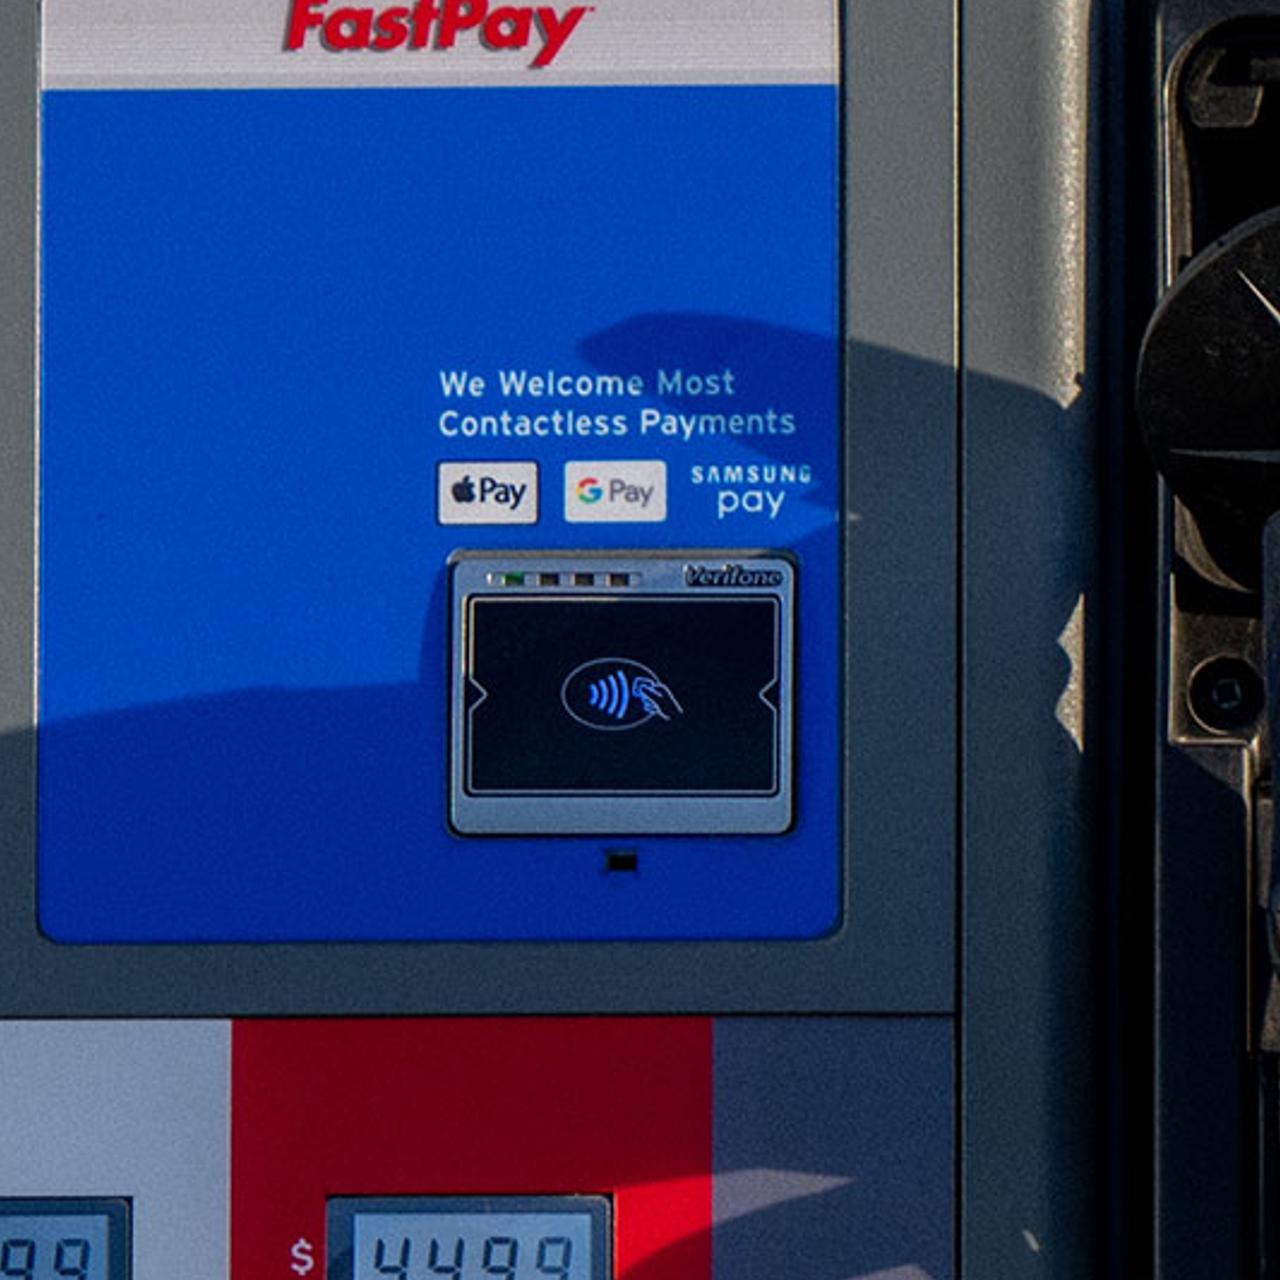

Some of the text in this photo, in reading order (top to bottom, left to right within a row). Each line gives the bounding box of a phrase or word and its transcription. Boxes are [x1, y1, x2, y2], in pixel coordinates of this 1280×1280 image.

[439, 369, 735, 397] We Welcome Most
[439, 408, 796, 442] Contactless Payments
[691, 465, 812, 485] SAMSUNG
[480, 477, 527, 509] Pay
[609, 478, 654, 507] Pay
[717, 489, 785, 519] pay
[683, 564, 784, 587] Verifone
[290, 1238, 314, 1276] $
